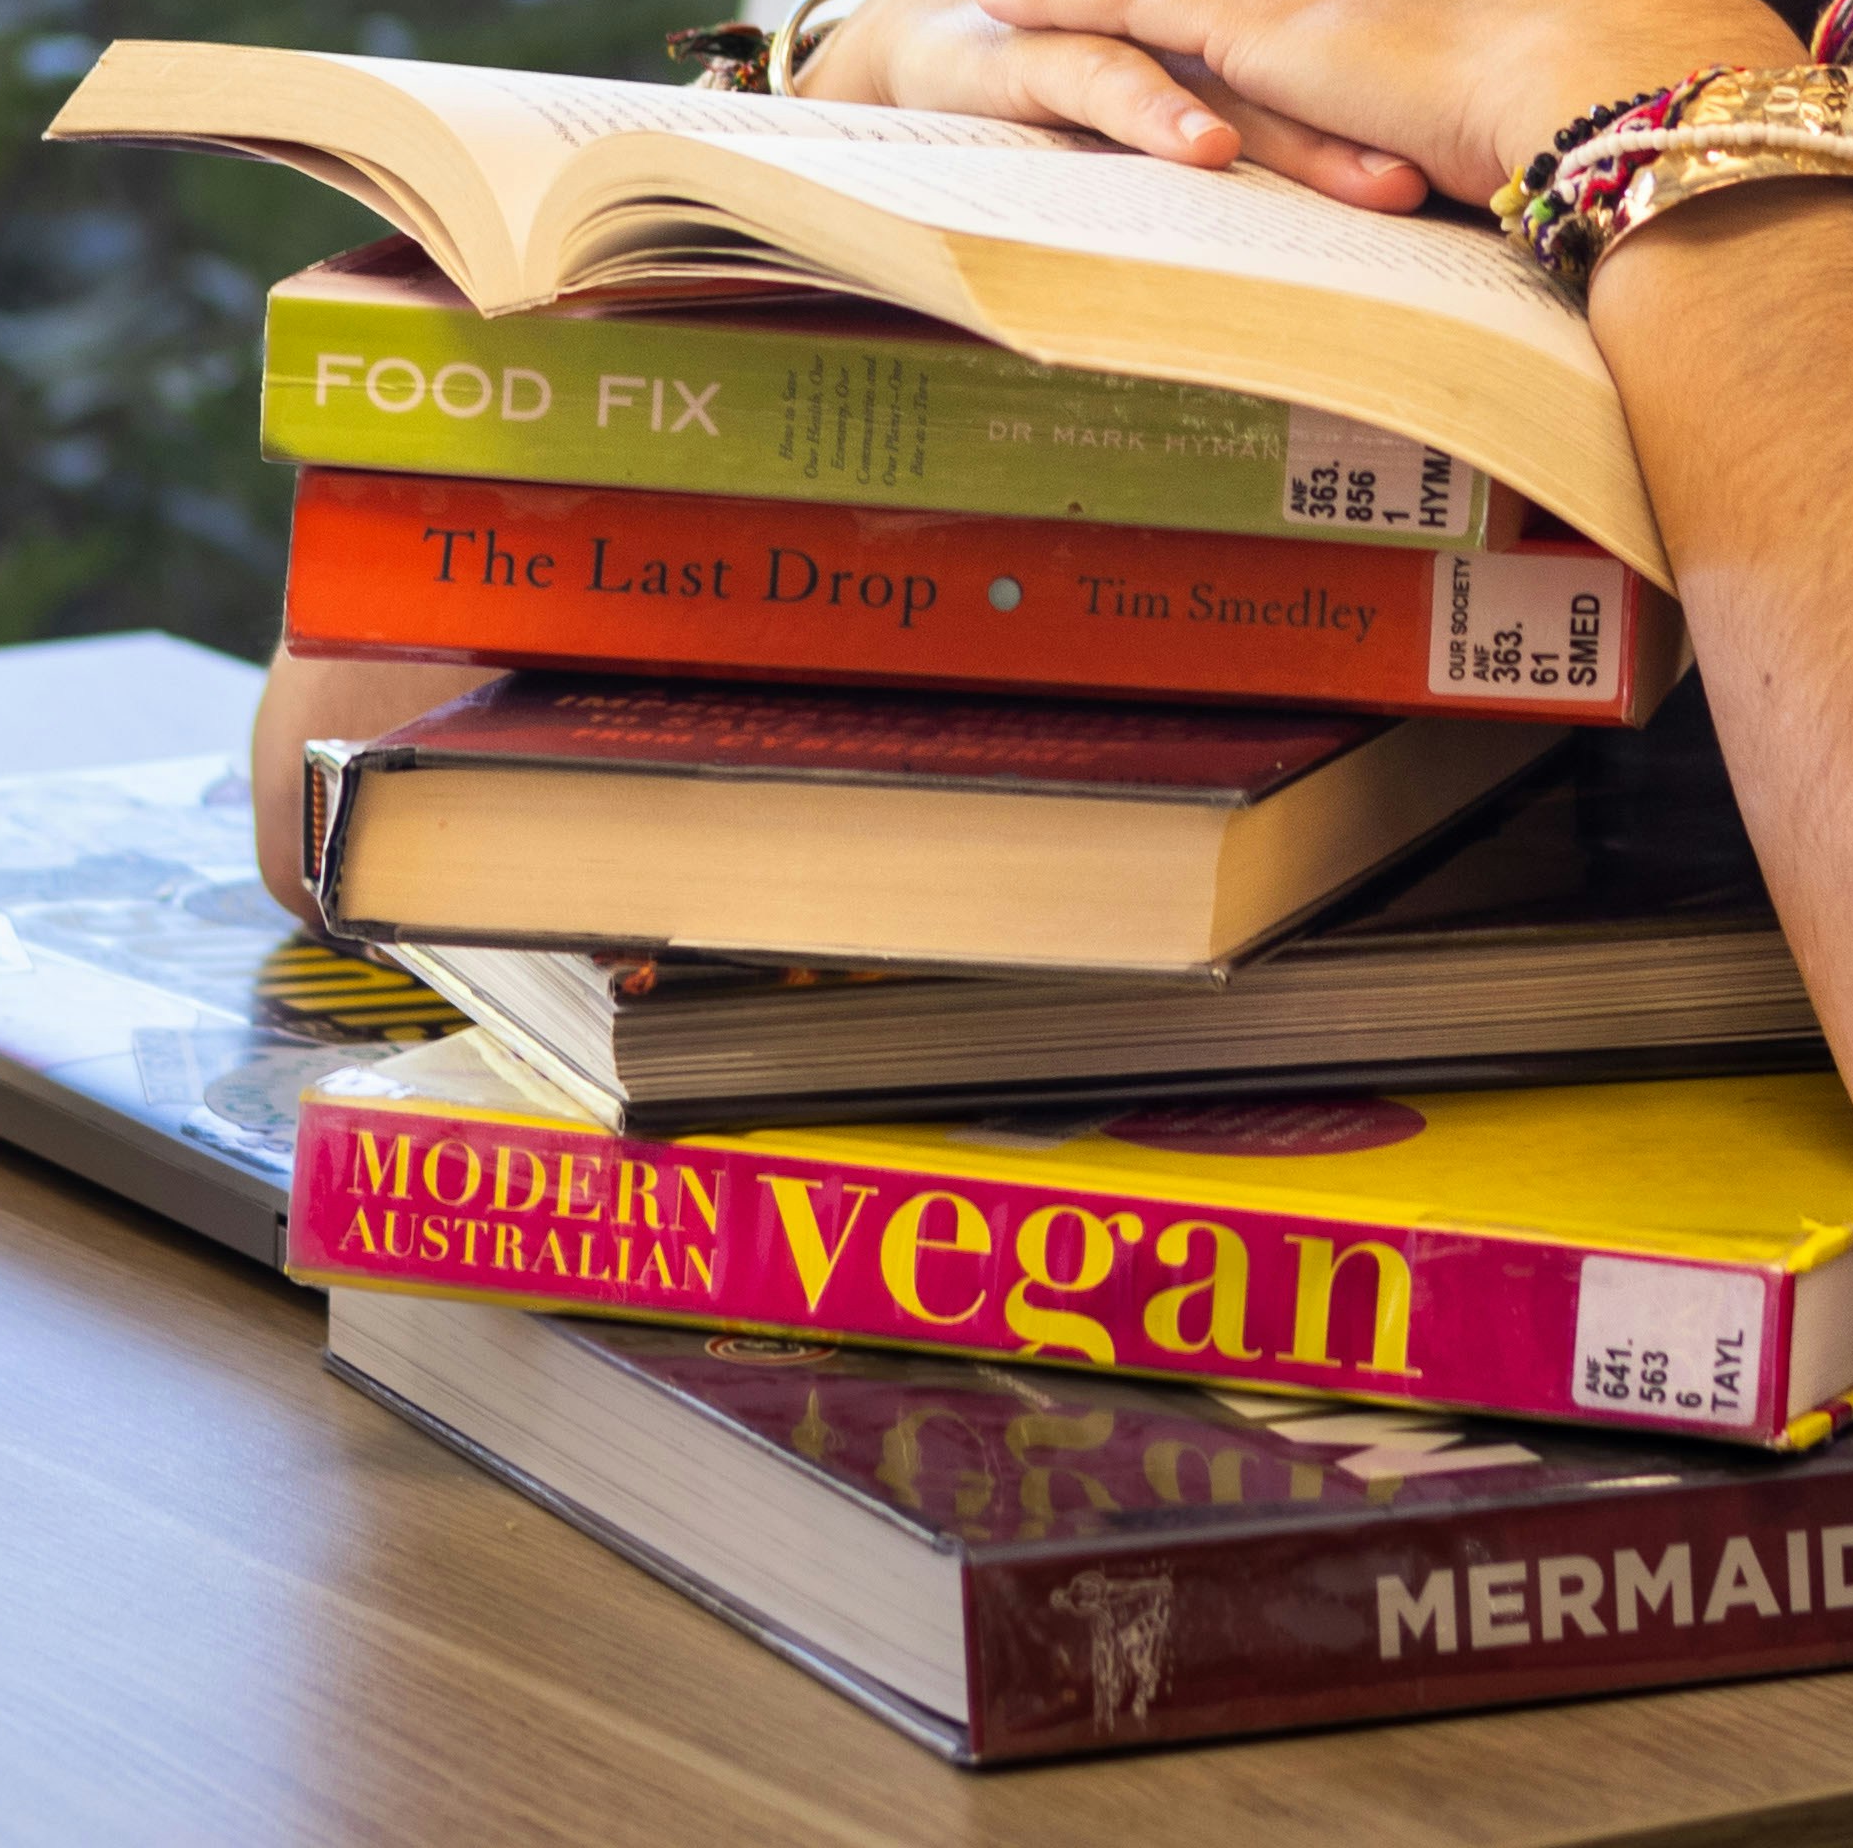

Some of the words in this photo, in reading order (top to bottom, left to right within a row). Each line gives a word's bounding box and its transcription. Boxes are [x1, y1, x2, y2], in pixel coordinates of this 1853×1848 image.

[314, 353, 553, 422] FOOD
[596, 374, 722, 437] FIX
[988, 420, 1033, 443] DR
[1053, 424, 1146, 451] MARK
[1164, 432, 1281, 462] HYMAN
[1290, 477, 1308, 515] ANF
[1308, 460, 1340, 519] 363.
[1345, 469, 1377, 522] 856
[1382, 509, 1410, 525] 1
[423, 527, 556, 592] The
[585, 536, 733, 601] Last
[762, 546, 939, 630] Drop
[1078, 575, 1171, 622] Tim
[1187, 581, 1378, 643] Smedley
[1451, 556, 1472, 636] SOCIETY
[1449, 639, 1466, 681] OUR
[1472, 643, 1490, 683] ANF
[1491, 621, 1524, 683] 363.
[1529, 652, 1560, 685] 61
[1566, 592, 1601, 687] SMED
[346, 1130, 728, 1235] MODERN
[340, 1203, 718, 1294] AUSTRALIAN
[756, 1173, 1423, 1378] vegan
[1602, 1338, 1634, 1400] 641.
[1639, 1349, 1669, 1405] 563
[1674, 1391, 1703, 1409] 6
[1710, 1328, 1744, 1413] TAYL
